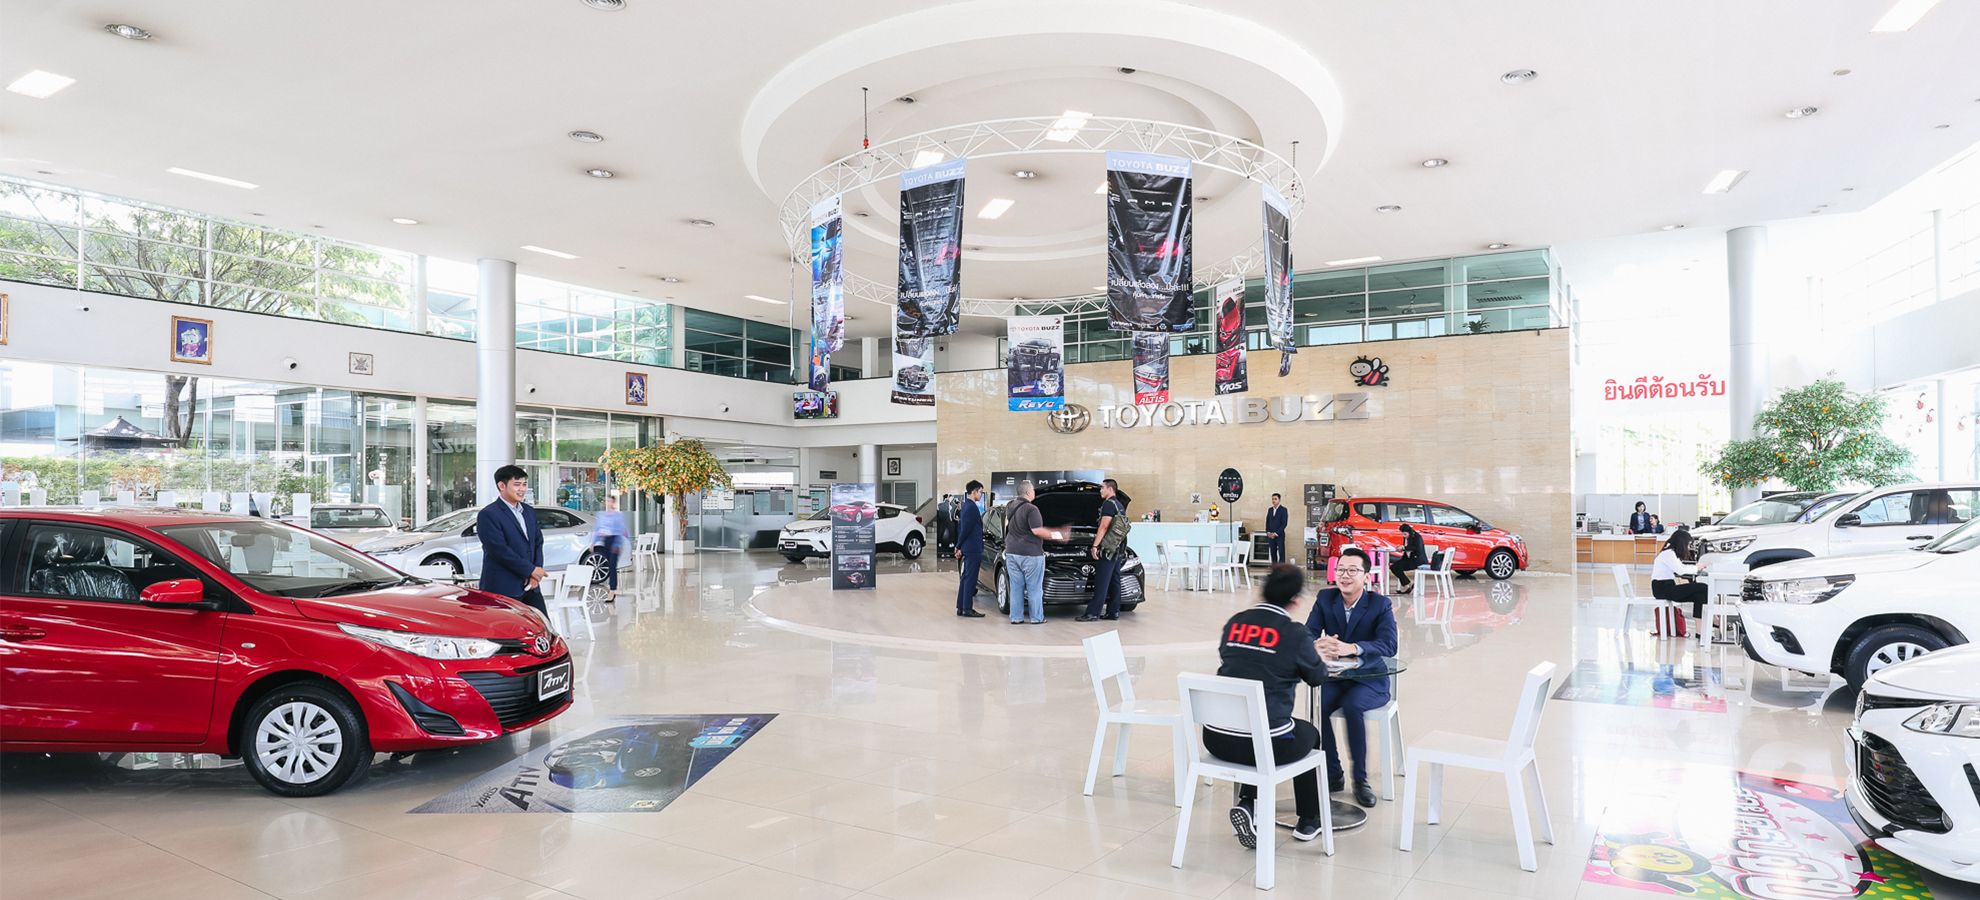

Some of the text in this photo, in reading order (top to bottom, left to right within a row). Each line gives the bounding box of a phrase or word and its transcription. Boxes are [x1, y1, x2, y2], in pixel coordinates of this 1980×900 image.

[904, 166, 964, 186] TOYOTA BUZZ
[1112, 158, 1189, 175] TOYOTA BUZZ
[1604, 373, 1726, 401] ยินดีต้อนรับ
[1098, 392, 1371, 430] TOYOTA BUZZ
[1139, 395, 1165, 404] ALTIS
[1227, 623, 1281, 648] HPD
[472, 786, 498, 809] YARIS
[498, 765, 542, 812] ATIV
